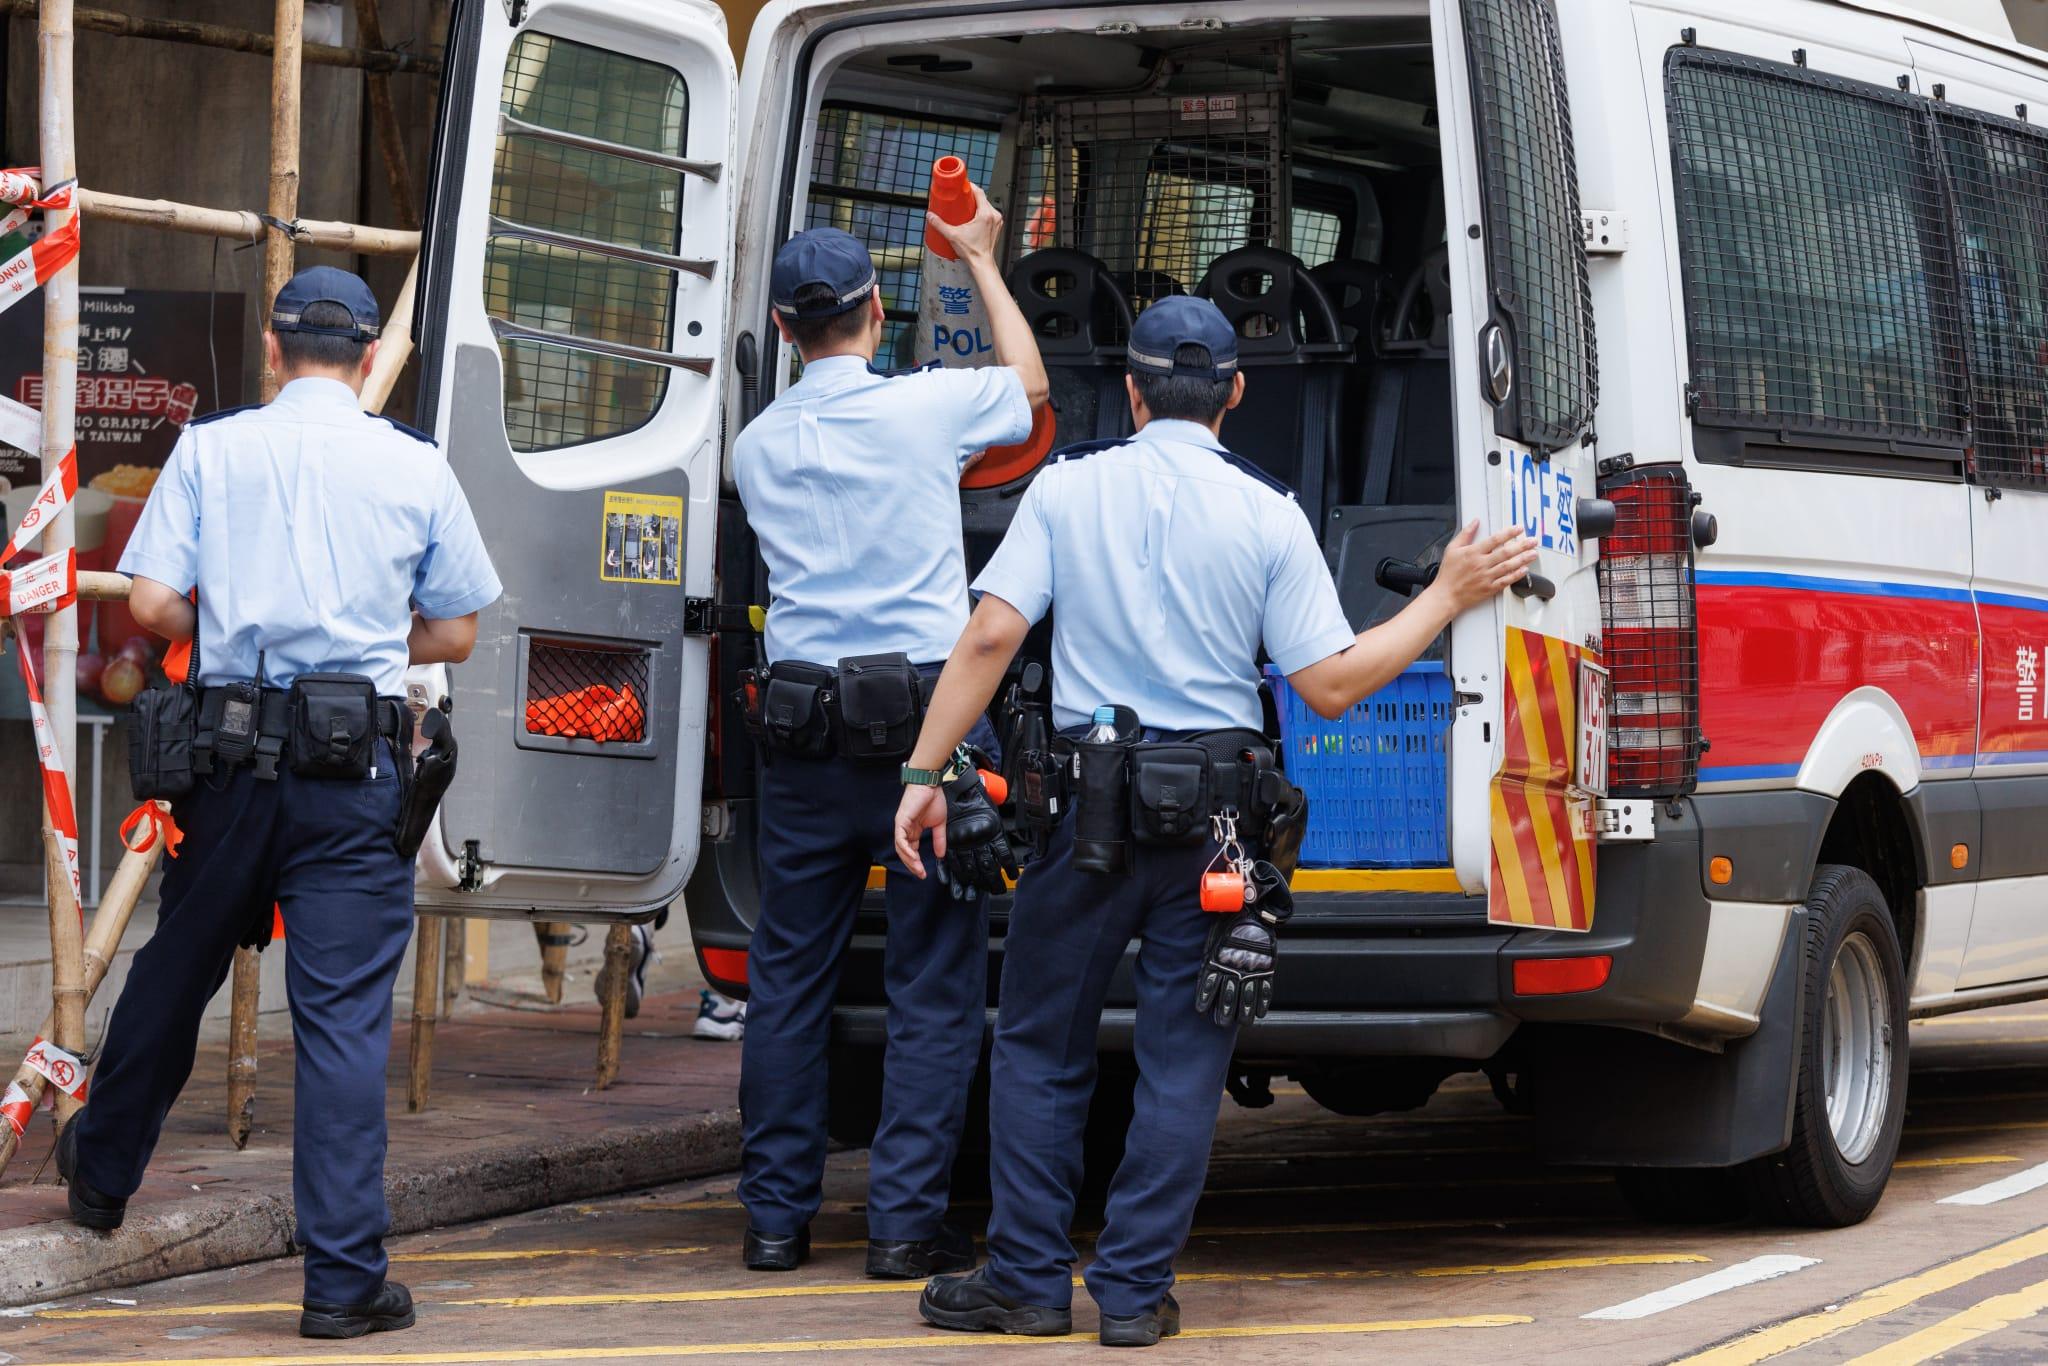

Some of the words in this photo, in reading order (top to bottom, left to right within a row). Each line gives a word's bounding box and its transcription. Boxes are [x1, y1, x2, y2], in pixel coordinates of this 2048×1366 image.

[84, 301, 135, 314] Milksha
[938, 286, 972, 315] 警
[99, 416, 150, 430] GRAPE
[90, 431, 142, 443] TAIWAN
[17, 580, 61, 605] DANGER
[2015, 646, 2038, 720] 警
